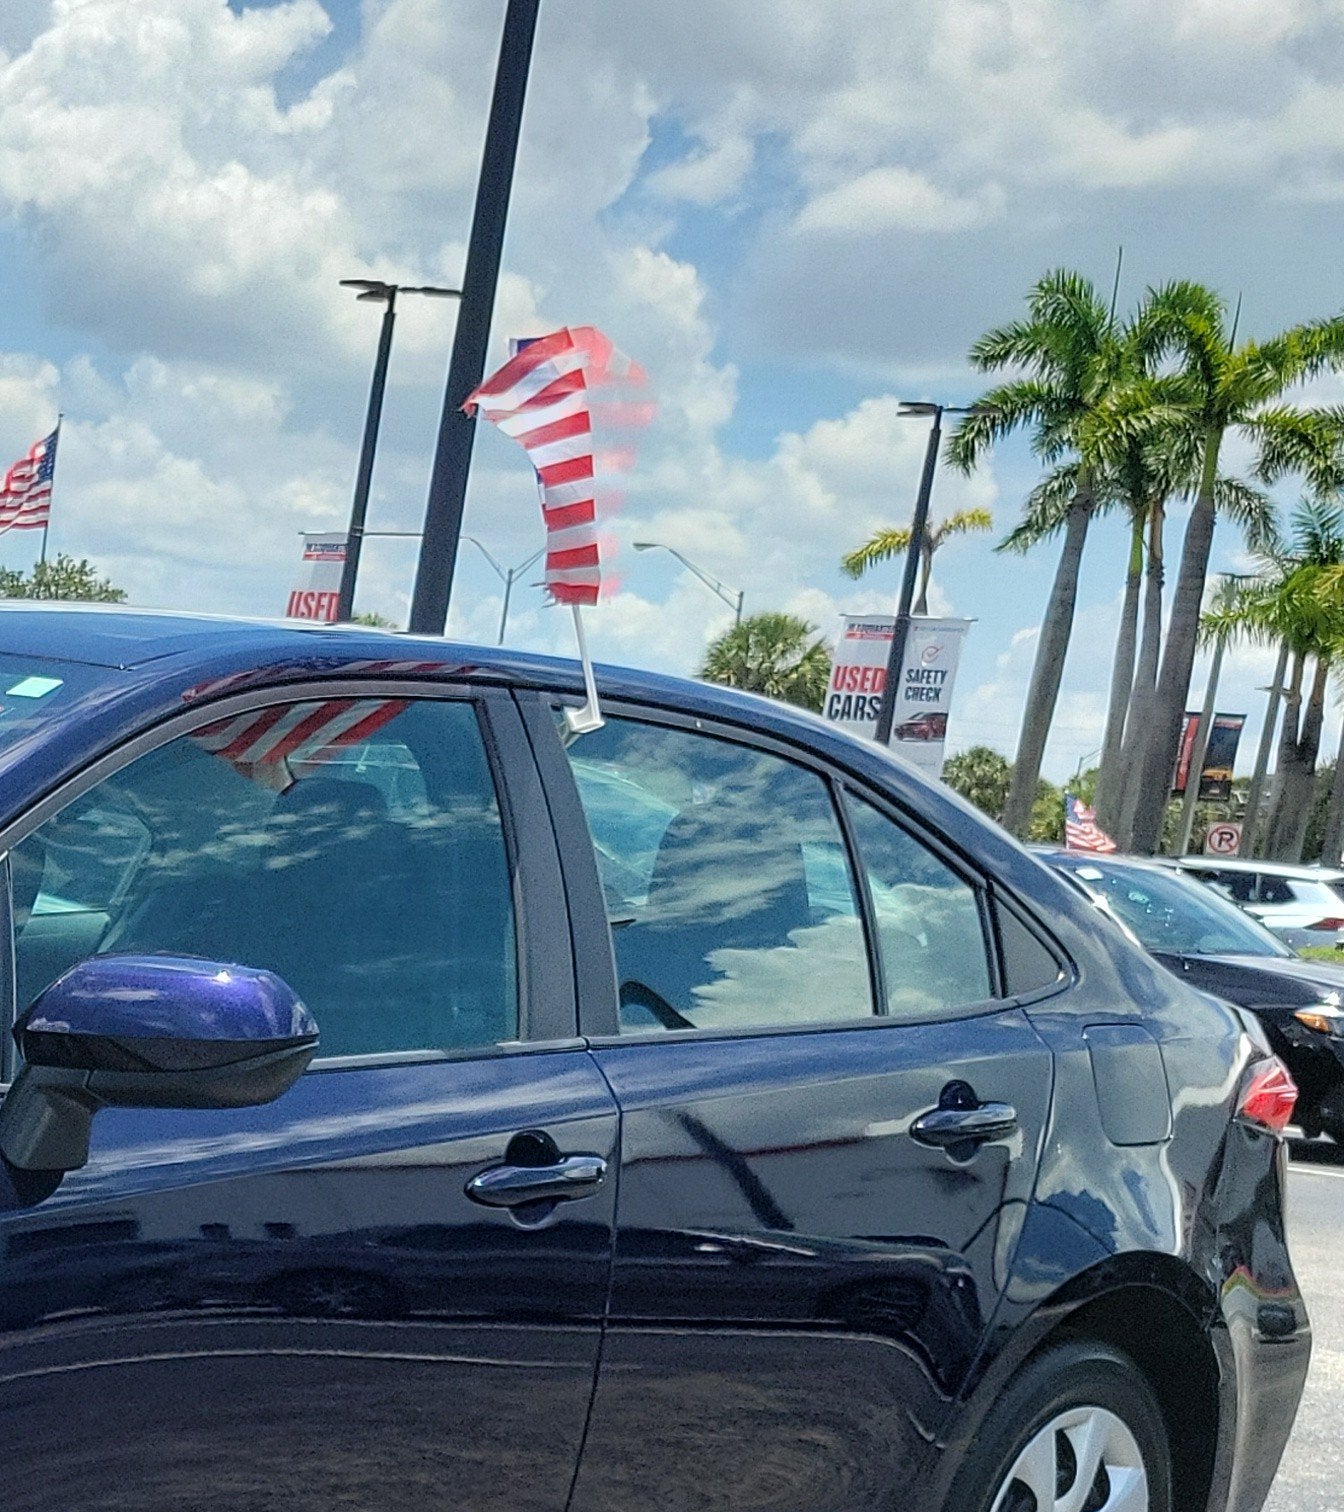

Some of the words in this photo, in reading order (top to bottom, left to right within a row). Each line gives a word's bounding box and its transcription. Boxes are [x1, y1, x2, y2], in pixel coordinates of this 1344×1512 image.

[833, 665, 889, 694] USED
[905, 668, 948, 685] SAFETY
[904, 686, 942, 703] CHECK
[827, 693, 883, 721] CARS
